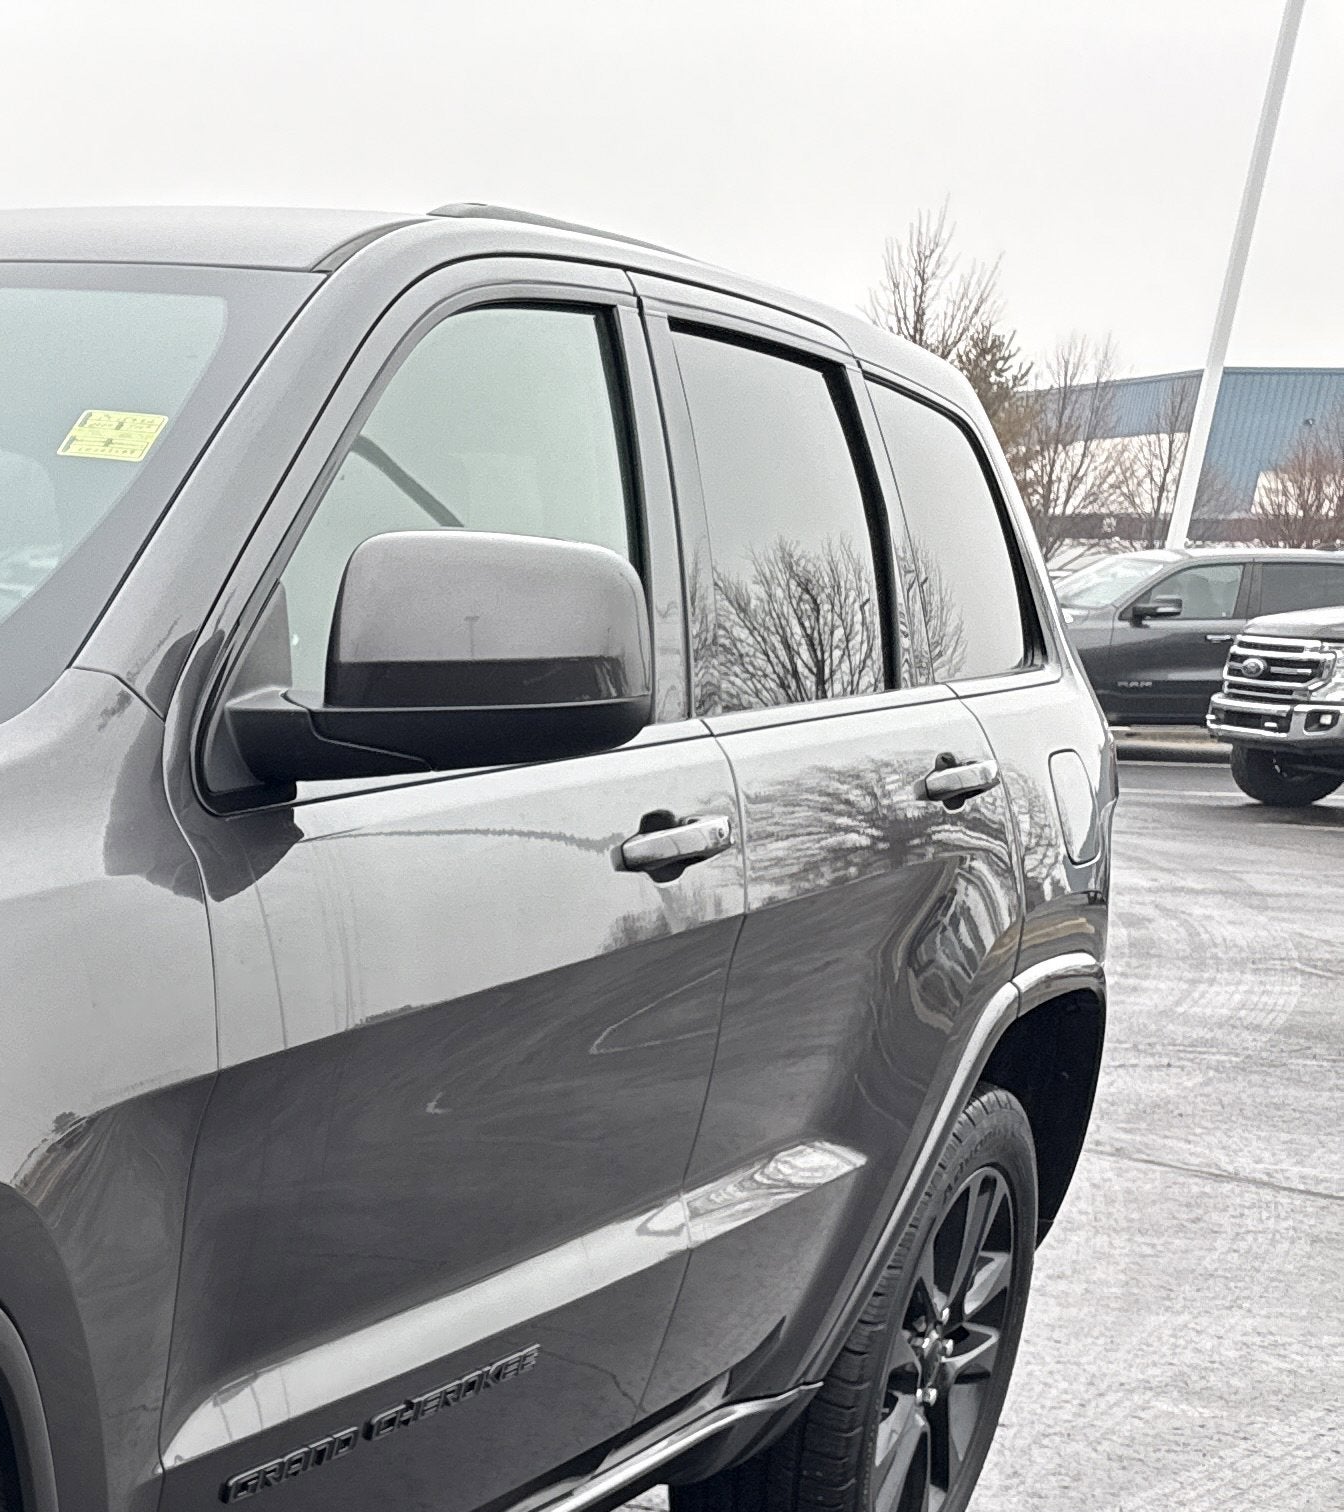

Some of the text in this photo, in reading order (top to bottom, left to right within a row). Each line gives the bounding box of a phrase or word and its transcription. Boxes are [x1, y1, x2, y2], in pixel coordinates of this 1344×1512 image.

[1116, 680, 1153, 689] RAM
[219, 1342, 543, 1505] GRAND CHEROKEE
